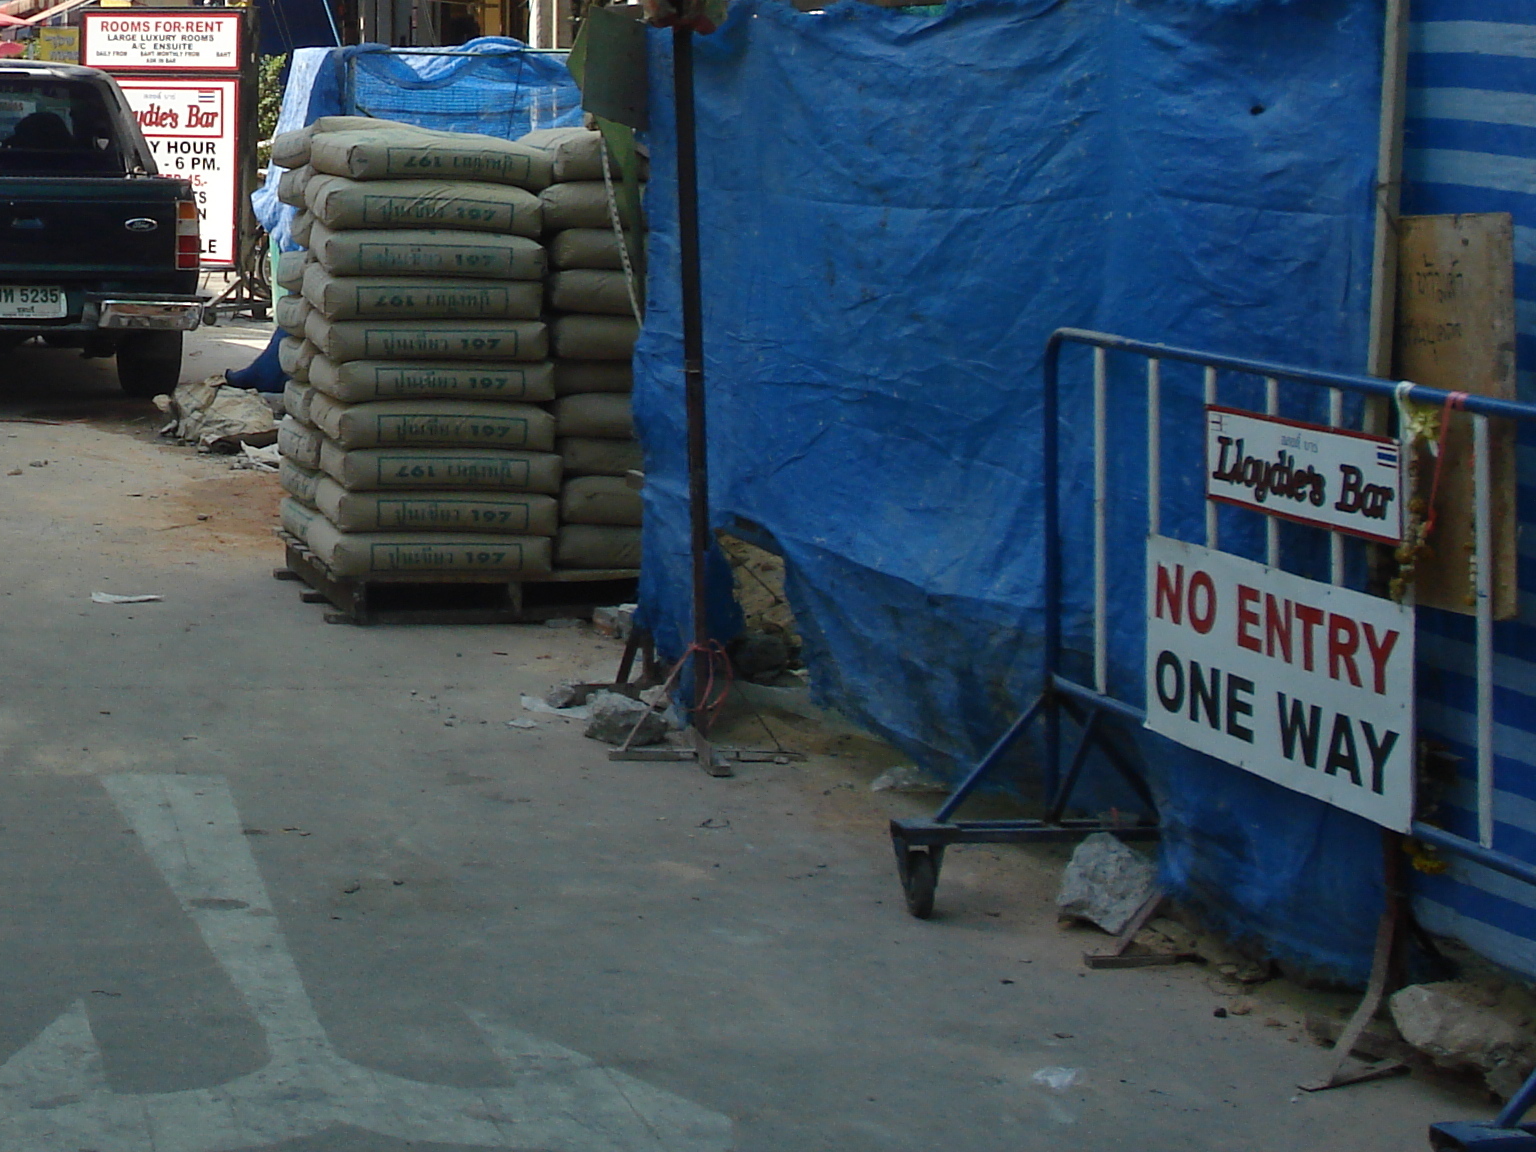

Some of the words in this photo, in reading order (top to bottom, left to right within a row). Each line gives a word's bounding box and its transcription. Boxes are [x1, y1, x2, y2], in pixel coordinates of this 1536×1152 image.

[101, 21, 150, 32] ROOMS
[155, 21, 224, 33] FOR-RENT
[107, 34, 137, 42] LARGE
[140, 34, 176, 42] LUXURY
[181, 34, 214, 42] ROOMS
[132, 103, 179, 129] ydie's
[185, 105, 218, 128] Bar
[167, 141, 216, 155] HOUR
[175, 157, 184, 170] 6
[192, 157, 221, 171] PM.
[199, 239, 217, 253] LE
[21, 289, 58, 303] 5235
[461, 338, 501, 349] 197
[469, 377, 508, 389] 197
[471, 425, 510, 437] 197
[396, 466, 435, 478] 197
[1212, 436, 1326, 507] Lloydie's
[1335, 464, 1394, 521] Bar
[471, 510, 511, 523] 197
[466, 552, 506, 564] 197
[1154, 561, 1217, 635] NO
[1236, 583, 1400, 696] ENTRY
[1155, 650, 1256, 745] ONE
[1276, 691, 1400, 796] WAY
